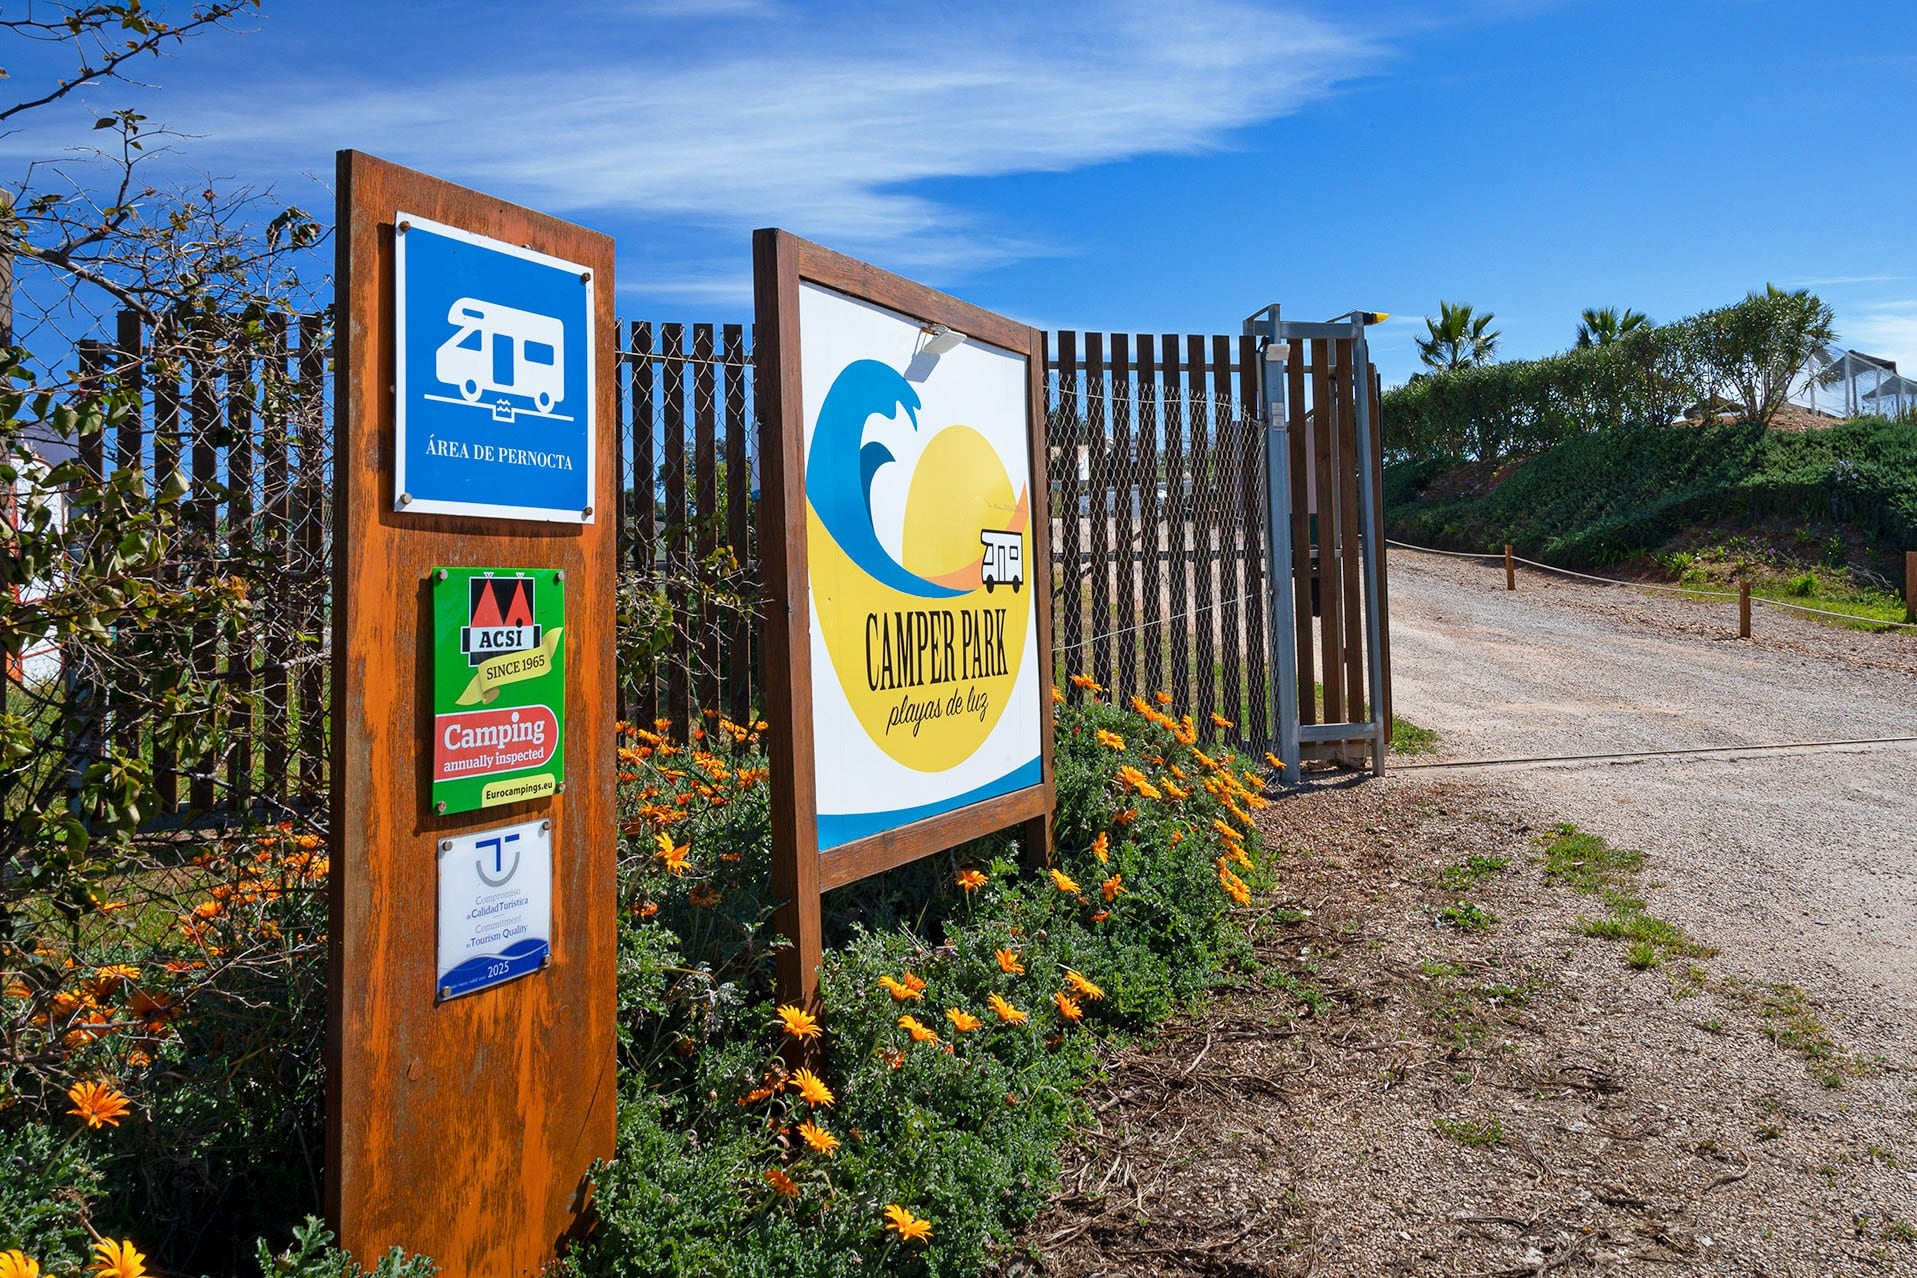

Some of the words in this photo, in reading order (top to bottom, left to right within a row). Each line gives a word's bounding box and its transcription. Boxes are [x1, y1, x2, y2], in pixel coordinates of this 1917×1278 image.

[425, 433, 469, 459] ÁREA
[473, 444, 495, 462] DE
[498, 447, 573, 471] PERNOCTA
[479, 629, 523, 648] ACSI
[865, 610, 956, 692] CAMPER
[960, 608, 1009, 681] PARK
[486, 660, 521, 680] SINCE
[522, 654, 545, 671] 1965
[885, 694, 943, 738] playas
[946, 687, 963, 717] de
[966, 685, 989, 723] luz
[444, 711, 545, 750] Camping
[443, 754, 494, 773] annually
[495, 747, 545, 765] inspected
[486, 781, 553, 800] Eurocampings.eu
[471, 905, 500, 918] Calidad
[470, 932, 501, 947] Tourism
[502, 925, 528, 938] Quality
[487, 960, 510, 979] 2025
